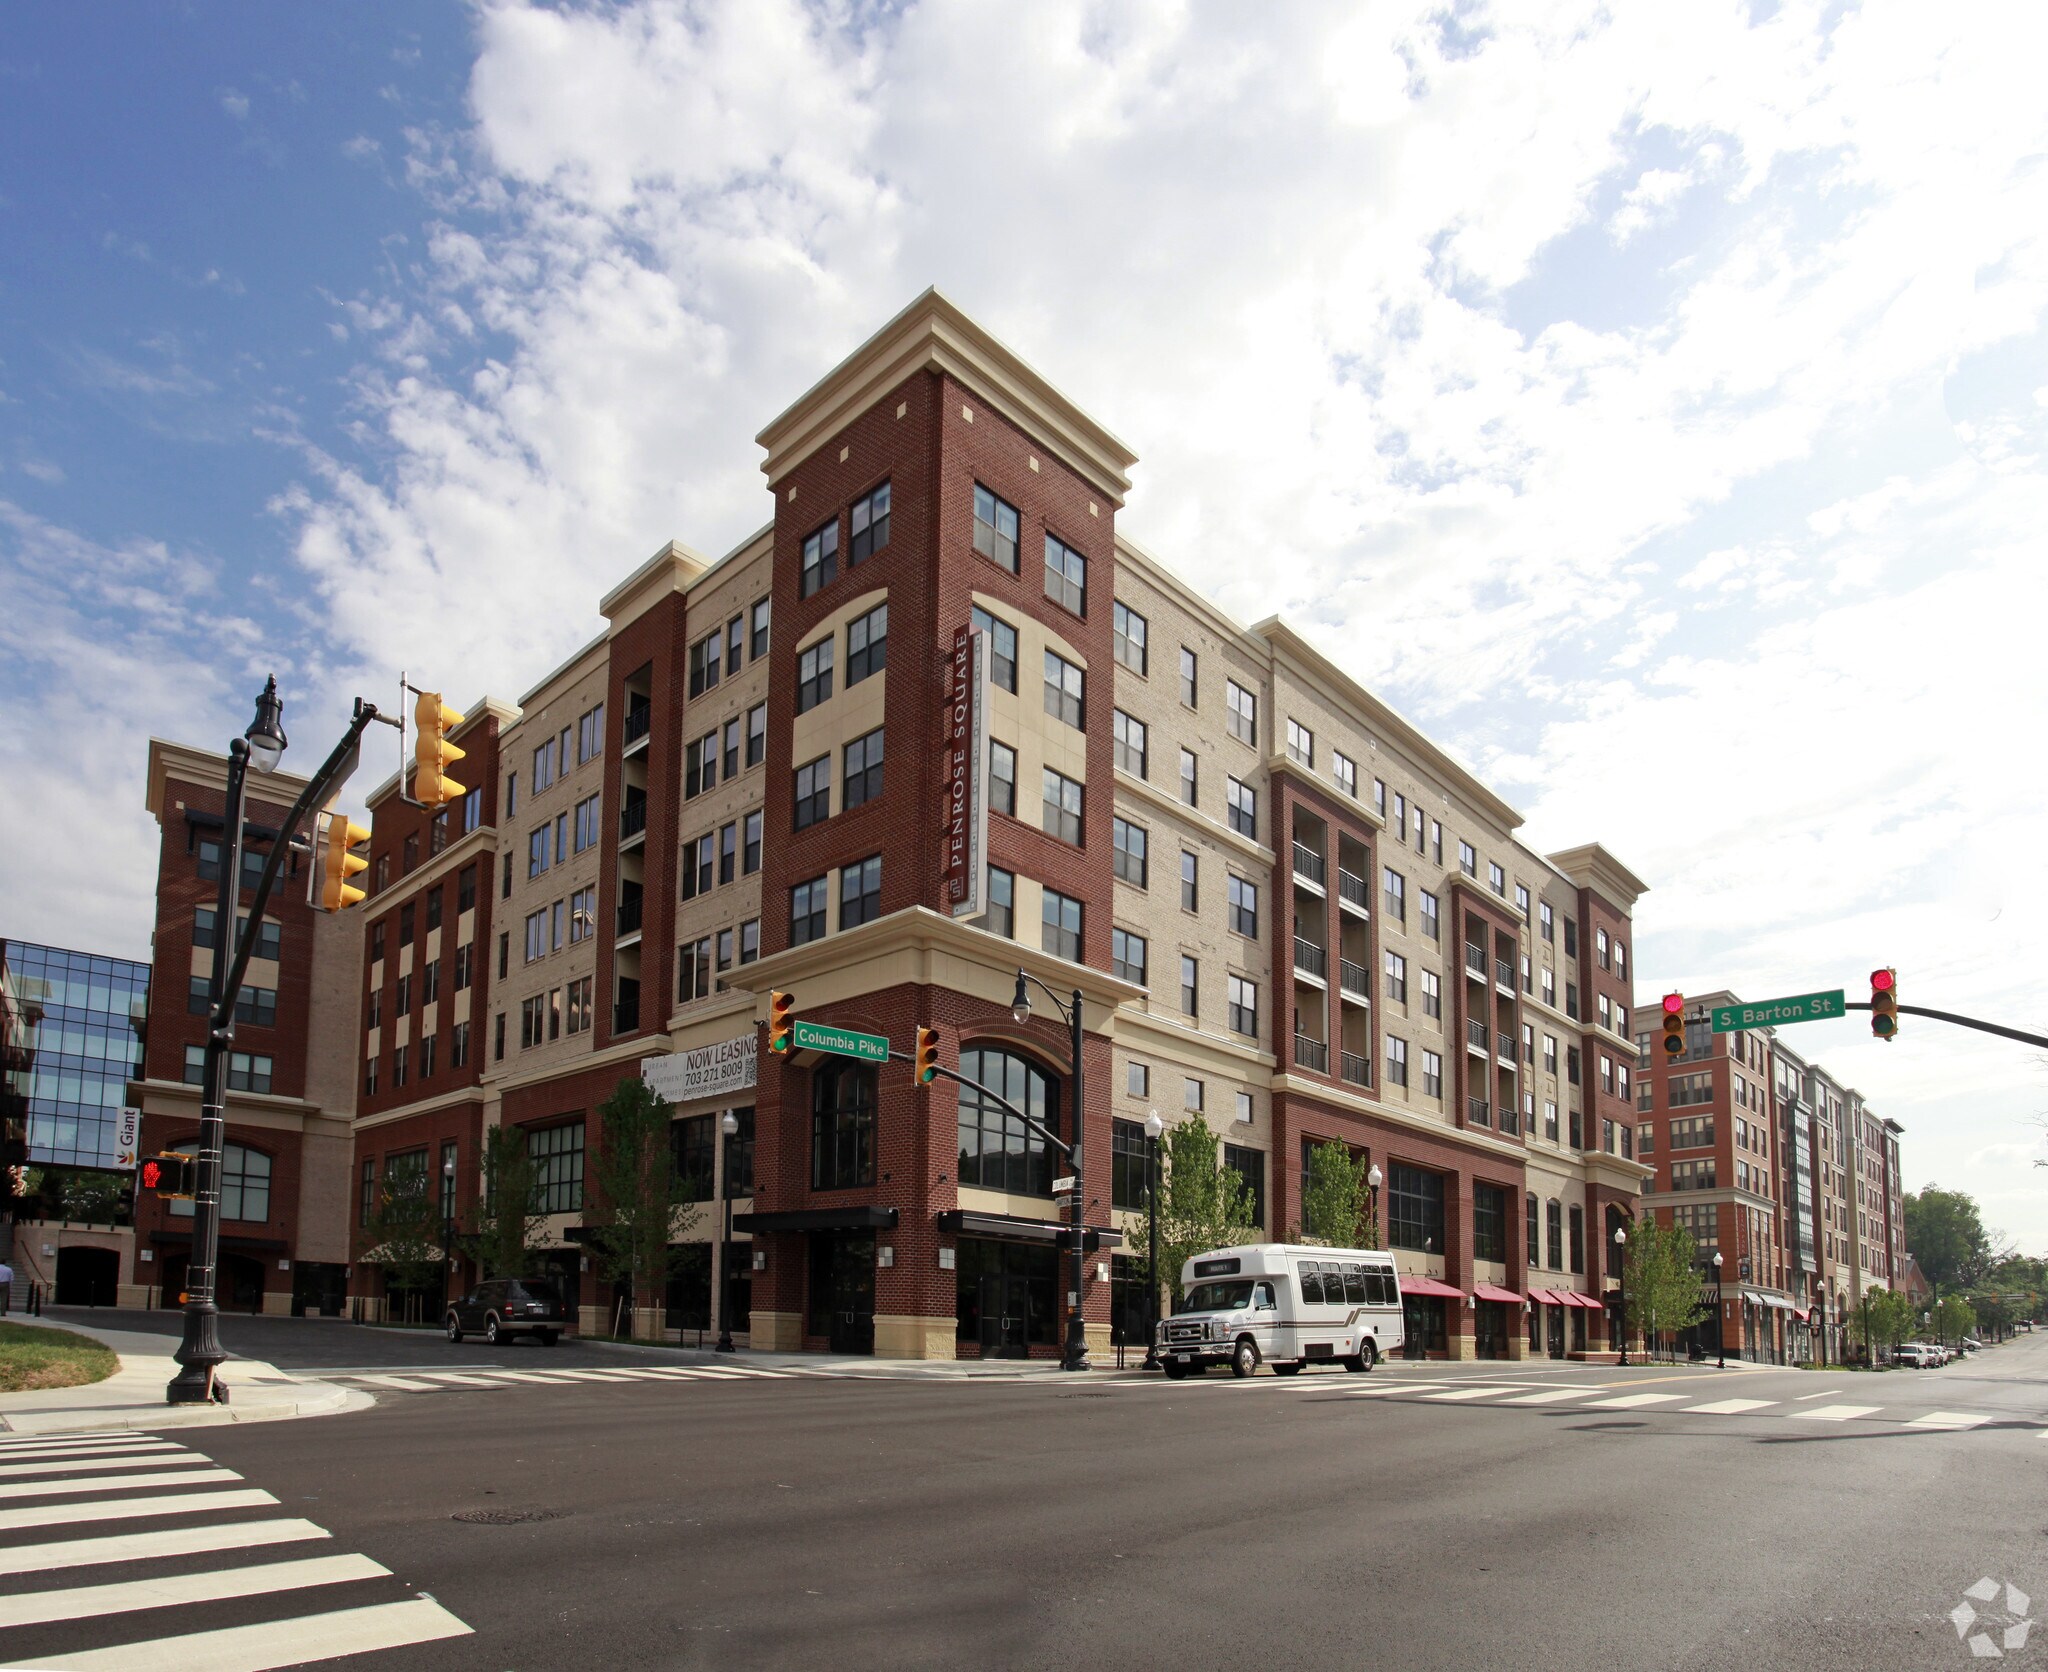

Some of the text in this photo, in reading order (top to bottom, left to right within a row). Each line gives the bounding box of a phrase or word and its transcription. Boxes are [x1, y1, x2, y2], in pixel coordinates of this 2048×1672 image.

[951, 633, 967, 867] PENROSE SQUARE
[1720, 999, 1835, 1026] S. Barton St.
[686, 1036, 758, 1071] NOW LEASING
[799, 1029, 884, 1056] Columbia Pike
[685, 1060, 743, 1086] 703 271 8009
[683, 1076, 743, 1098] penrose-square.com
[120, 1110, 136, 1146] Giant
